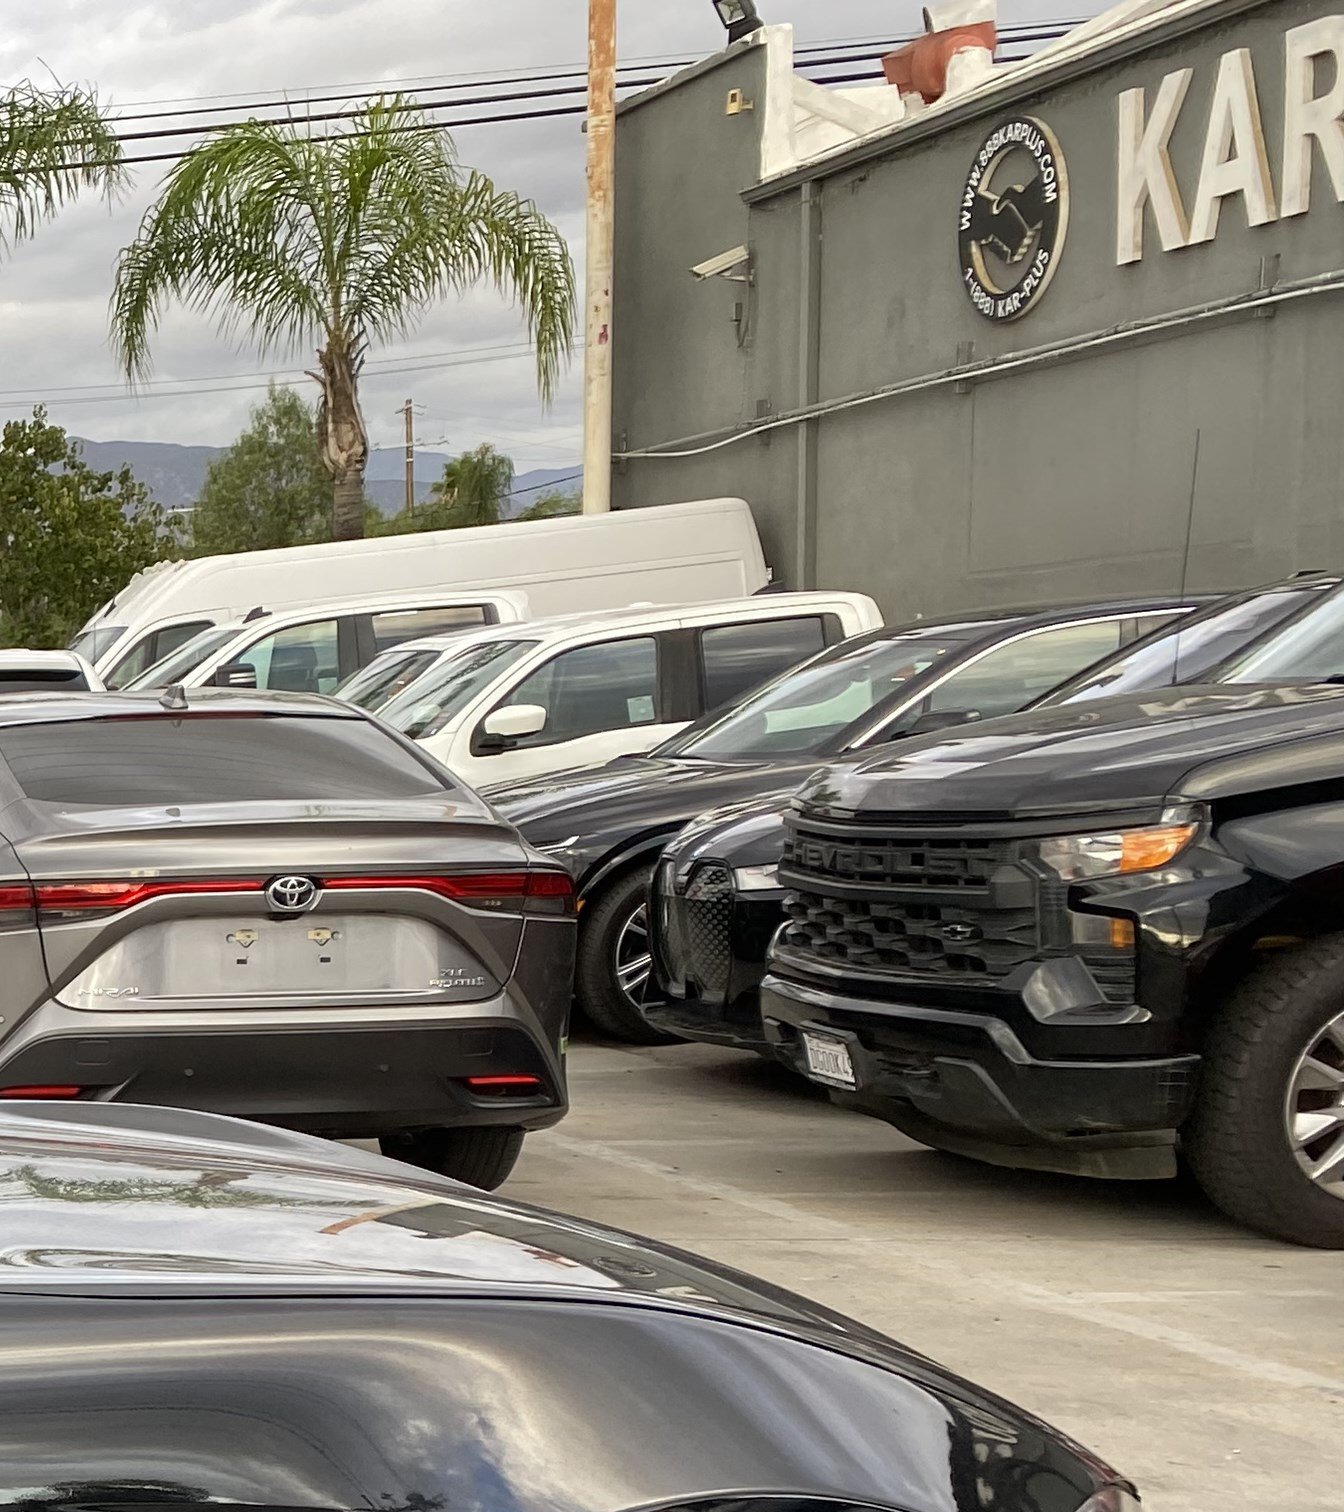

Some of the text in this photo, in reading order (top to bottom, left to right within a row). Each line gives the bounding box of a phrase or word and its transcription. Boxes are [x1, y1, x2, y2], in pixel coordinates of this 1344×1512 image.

[960, 122, 1058, 231] WWW.888KARPLUS.COM
[1116, 14, 1344, 266] KAR
[998, 249, 1050, 318] KAR-PLUS
